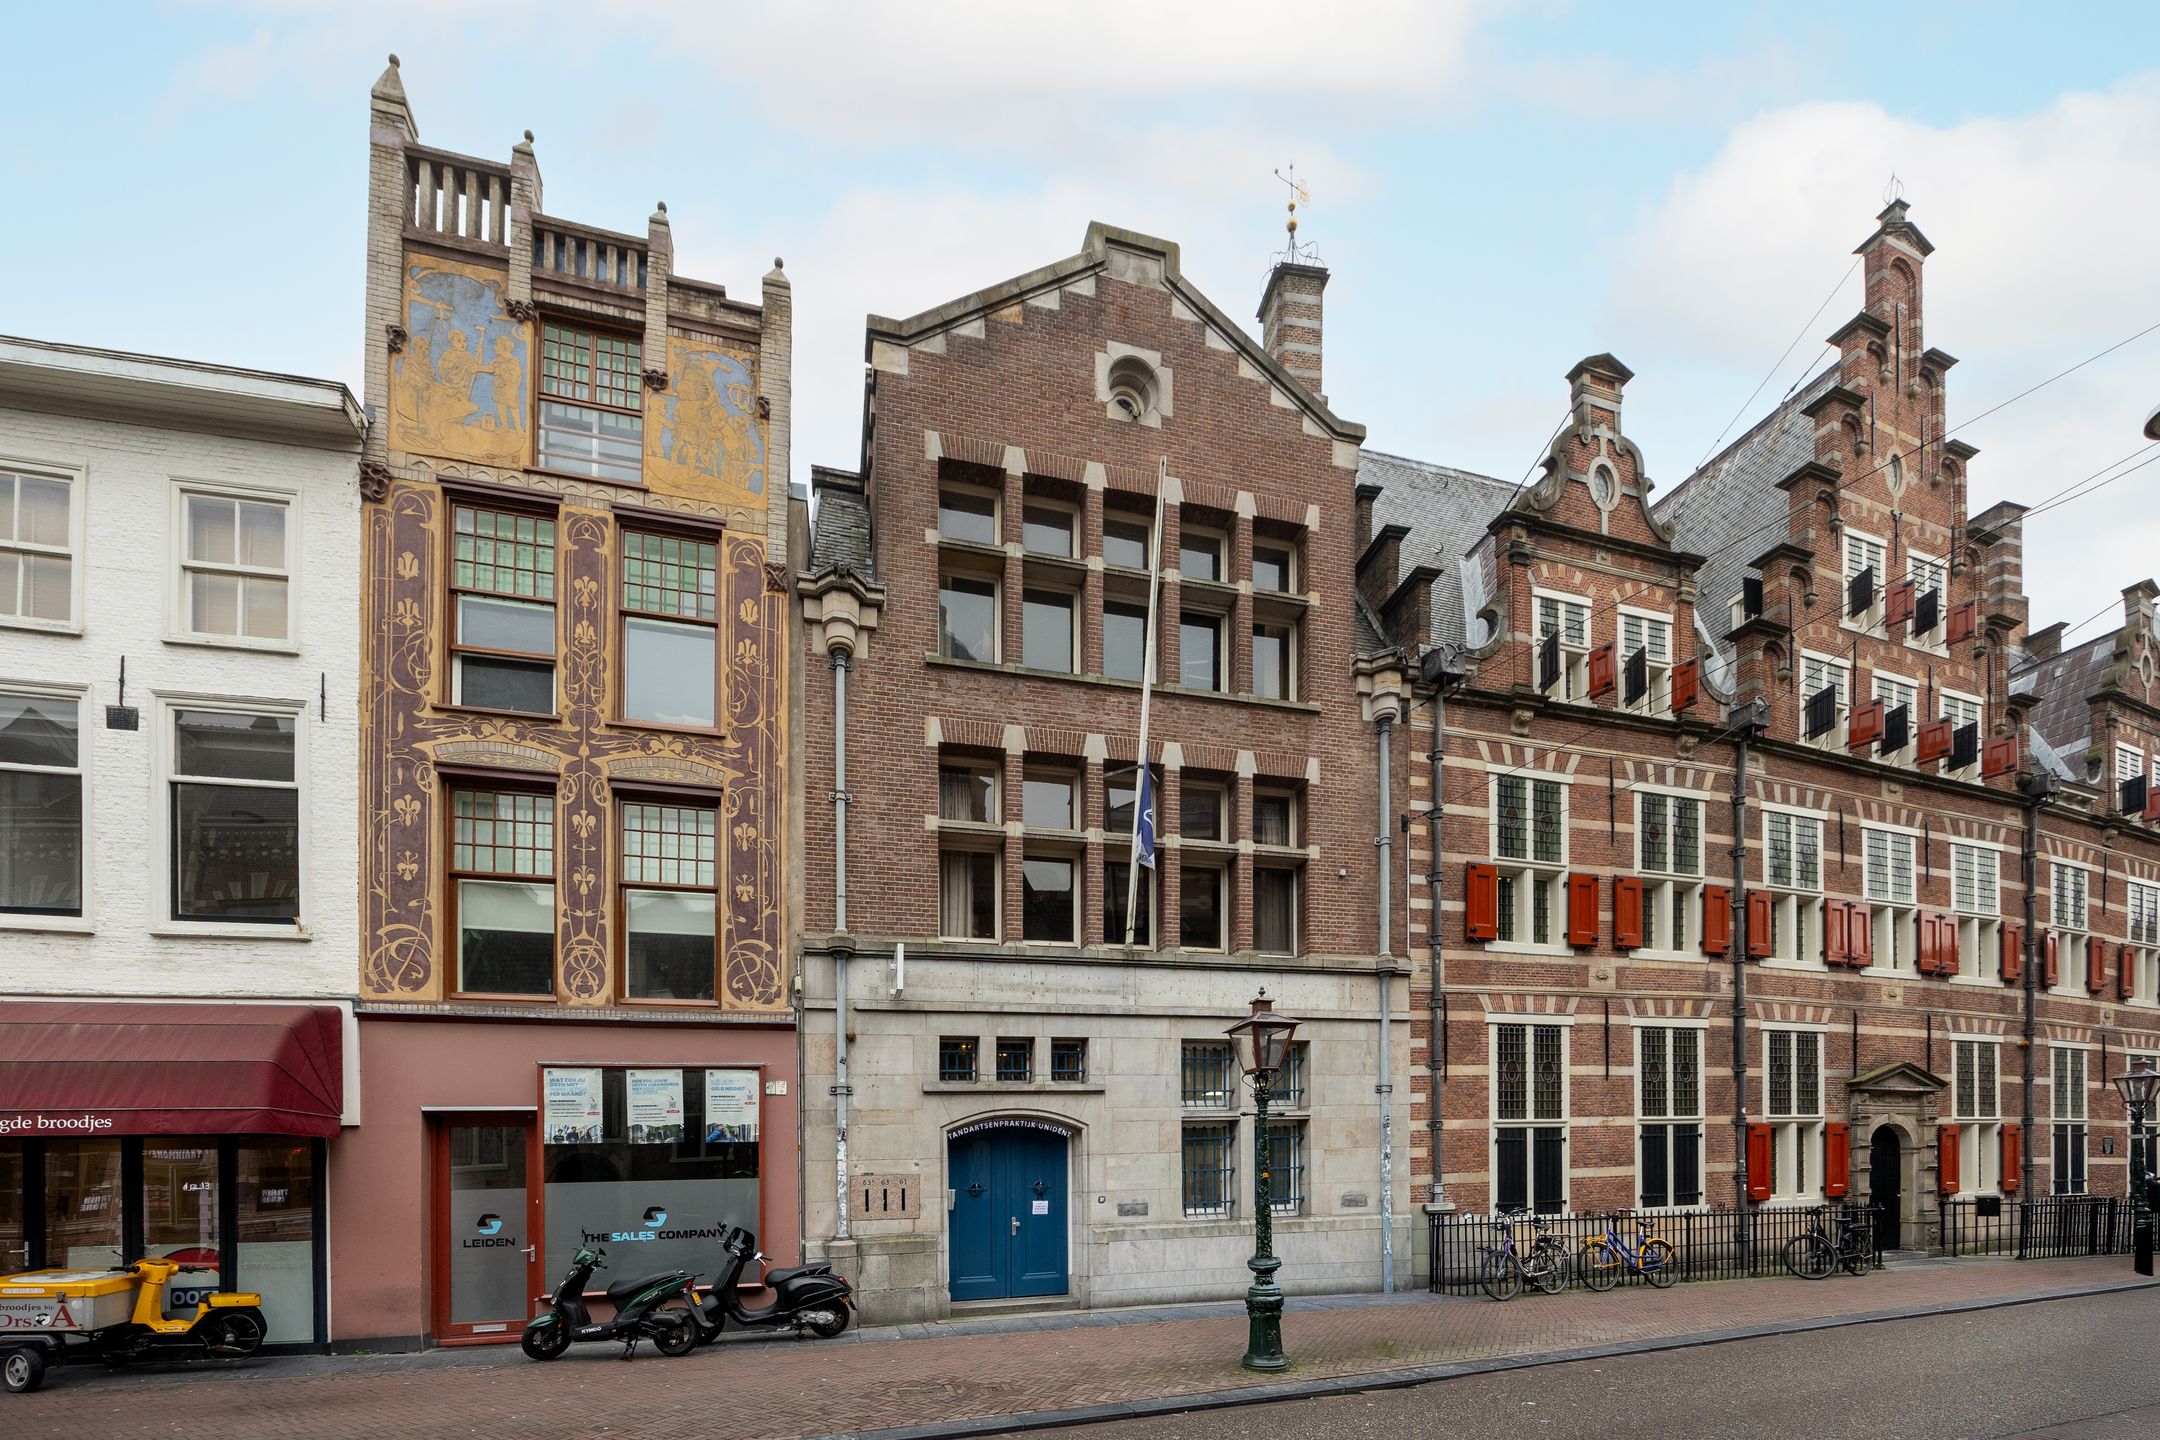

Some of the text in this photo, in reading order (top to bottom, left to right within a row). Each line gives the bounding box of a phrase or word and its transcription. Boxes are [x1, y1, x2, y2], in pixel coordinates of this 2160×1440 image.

[0, 1115, 112, 1134] gde broodjes
[947, 1120, 1072, 1140] TANDARTSENPRAKTIJK UNIDENT
[463, 1237, 516, 1249] LEIDEN
[584, 1228, 726, 1243] THE SALES COMPANY
[581, 1326, 602, 1334] KYMCO
